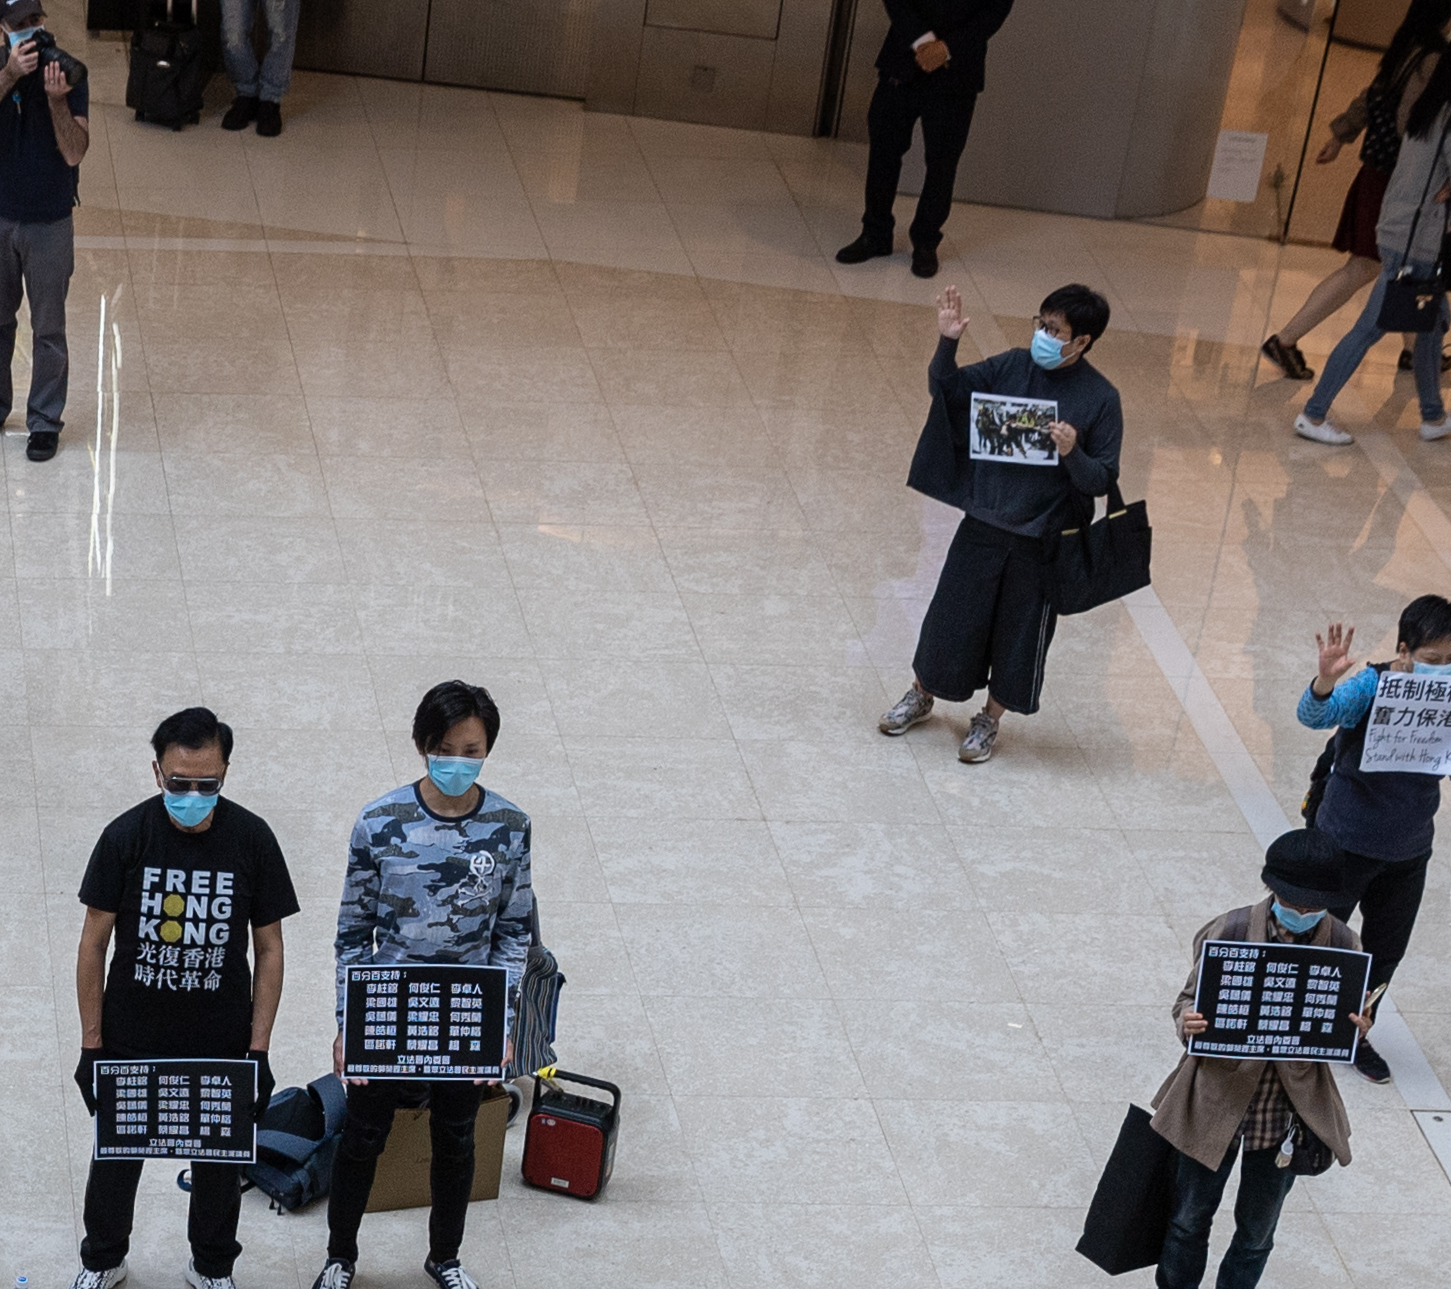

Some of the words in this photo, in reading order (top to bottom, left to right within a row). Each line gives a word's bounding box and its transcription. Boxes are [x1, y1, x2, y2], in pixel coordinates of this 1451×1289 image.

[1369, 728, 1390, 748] Fight
[1393, 730, 1406, 743] for
[1365, 749, 1395, 763] Stand
[1395, 749, 1415, 762] with
[1417, 749, 1441, 771] Hong
[142, 866, 234, 895] FREE
[136, 942, 226, 968] 光復香港
[134, 964, 222, 992] 時代革命
